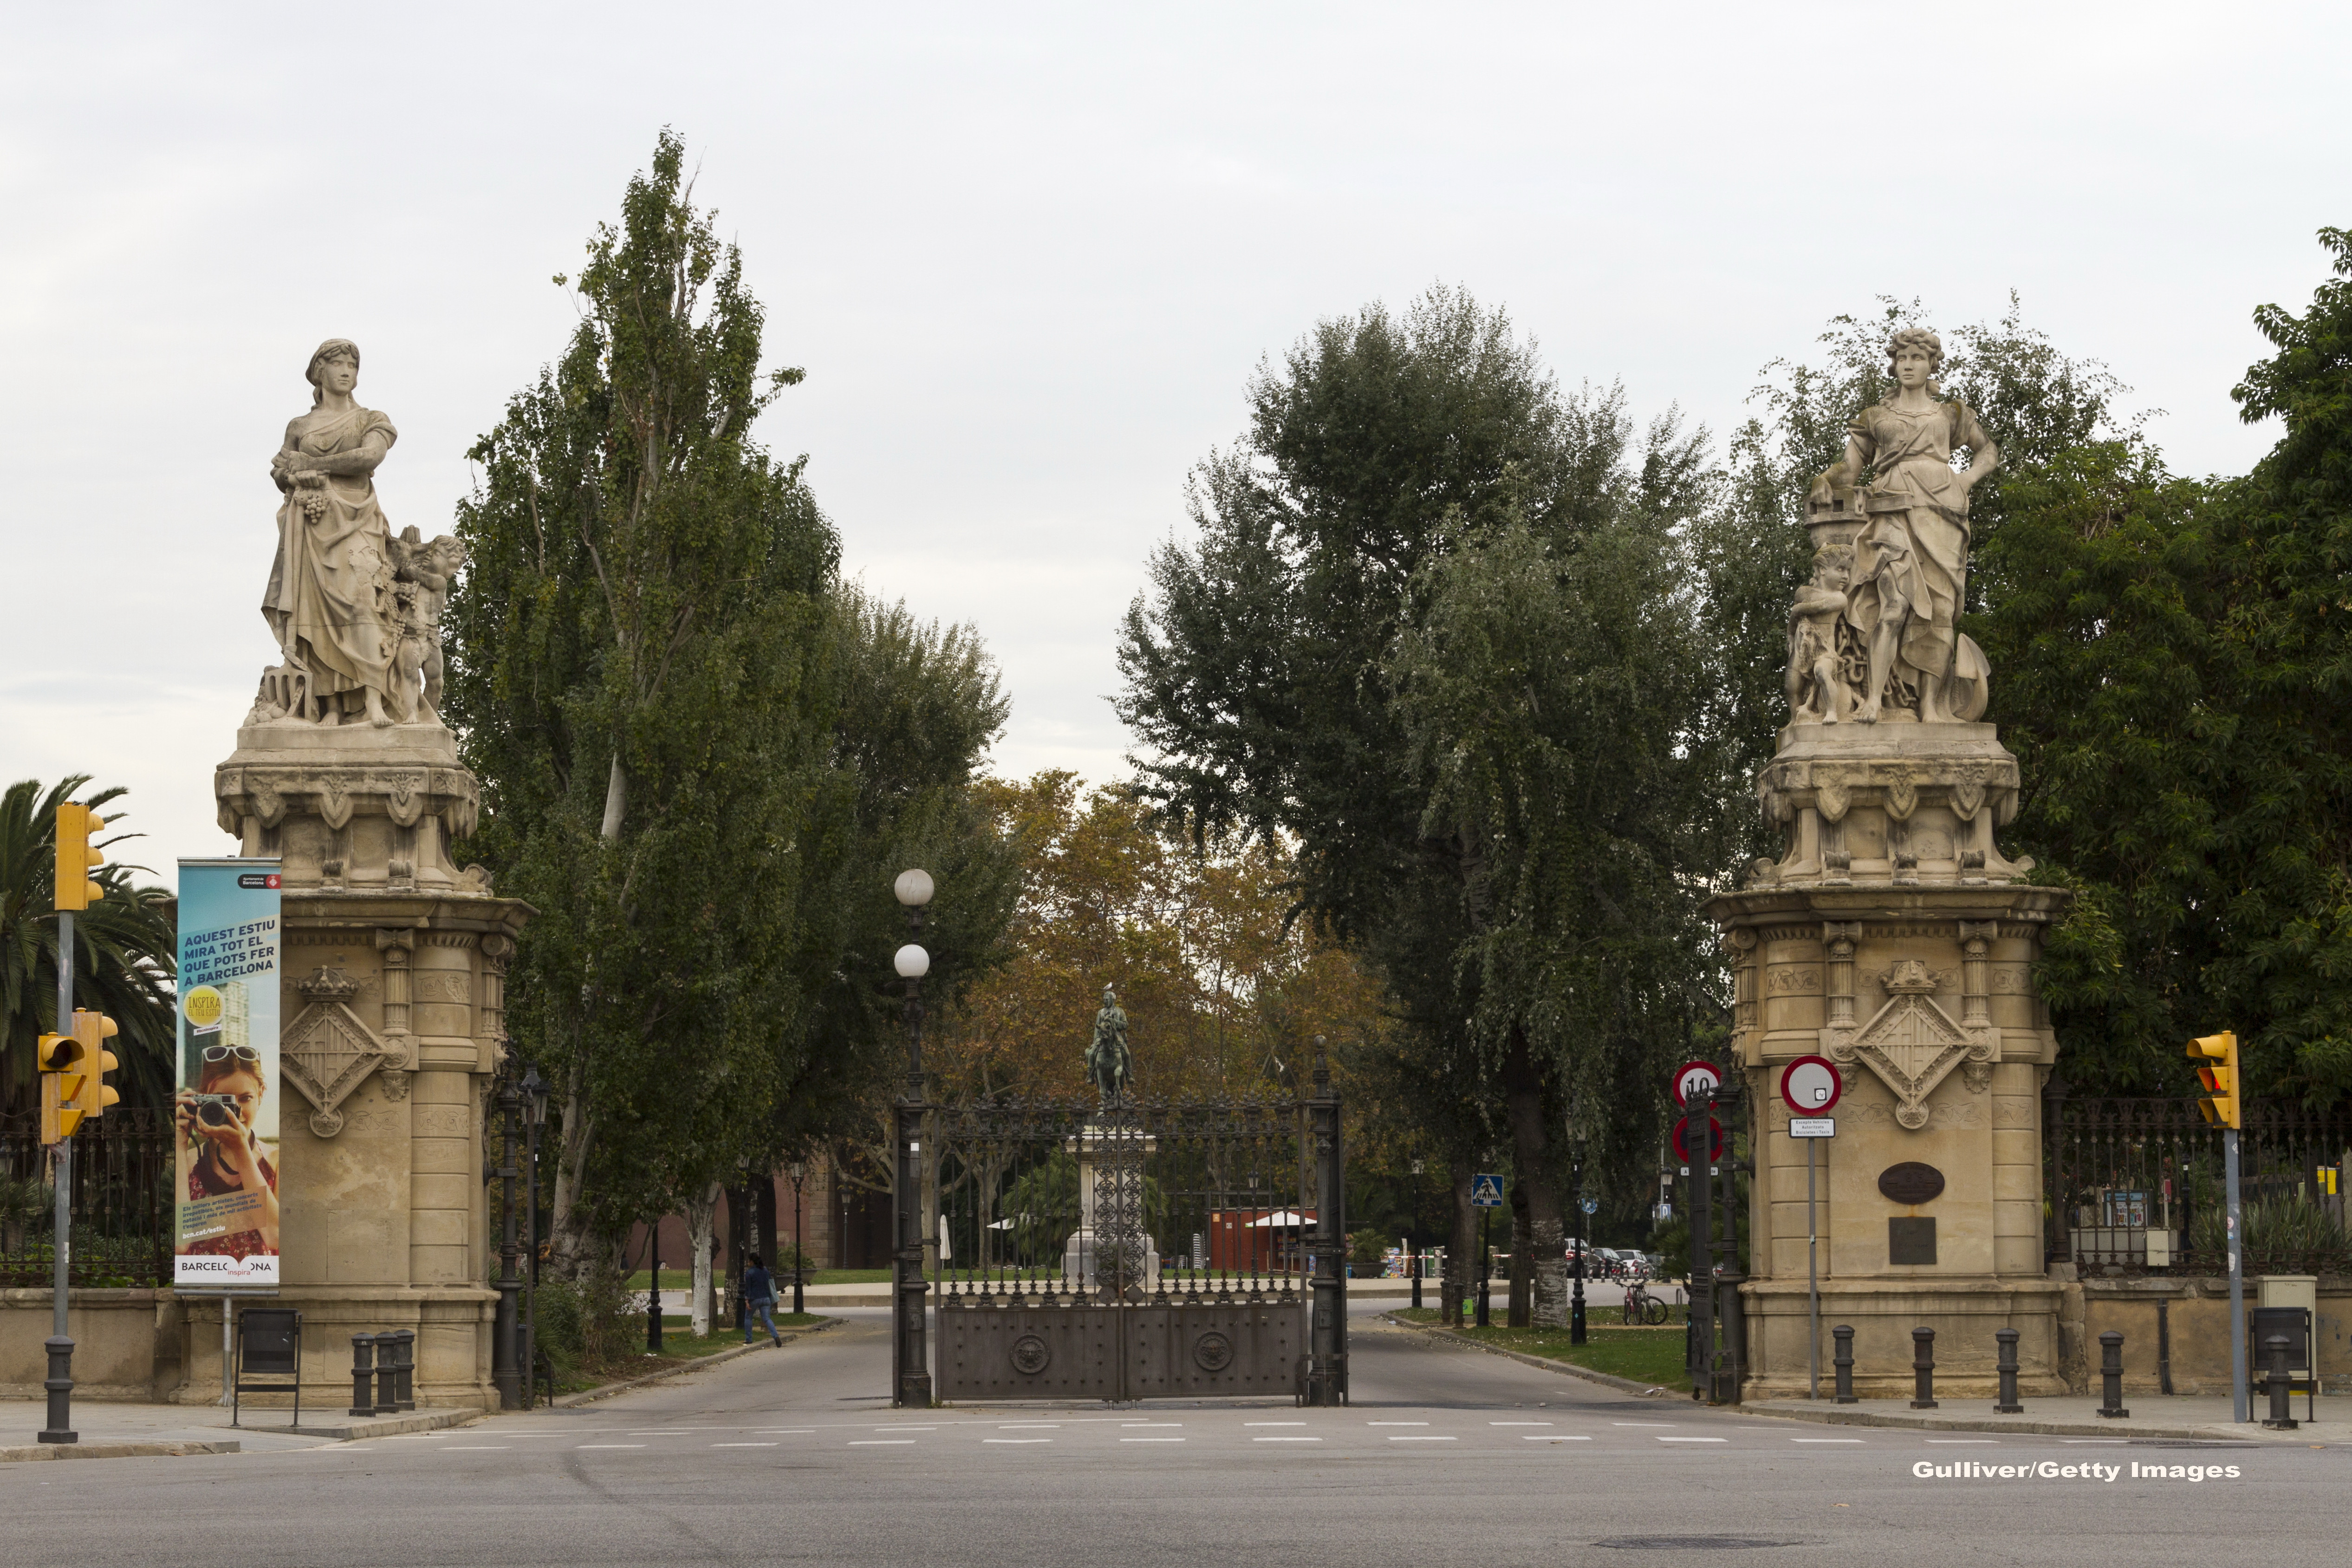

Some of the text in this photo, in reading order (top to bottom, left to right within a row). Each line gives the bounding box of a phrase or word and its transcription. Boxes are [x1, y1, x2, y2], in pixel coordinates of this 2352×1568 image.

[185, 920, 275, 947] AQUEST ESTIU
[185, 936, 263, 960] MIRA TOT EL
[184, 946, 274, 973] QUE POTS FER
[184, 960, 273, 986] A BARCELONA
[188, 997, 220, 1008] INSPIRA
[1688, 1077, 1709, 1094] 10
[182, 1208, 214, 1217] irrepetibles,
[182, 1225, 225, 1239] bcn.cat/estiu
